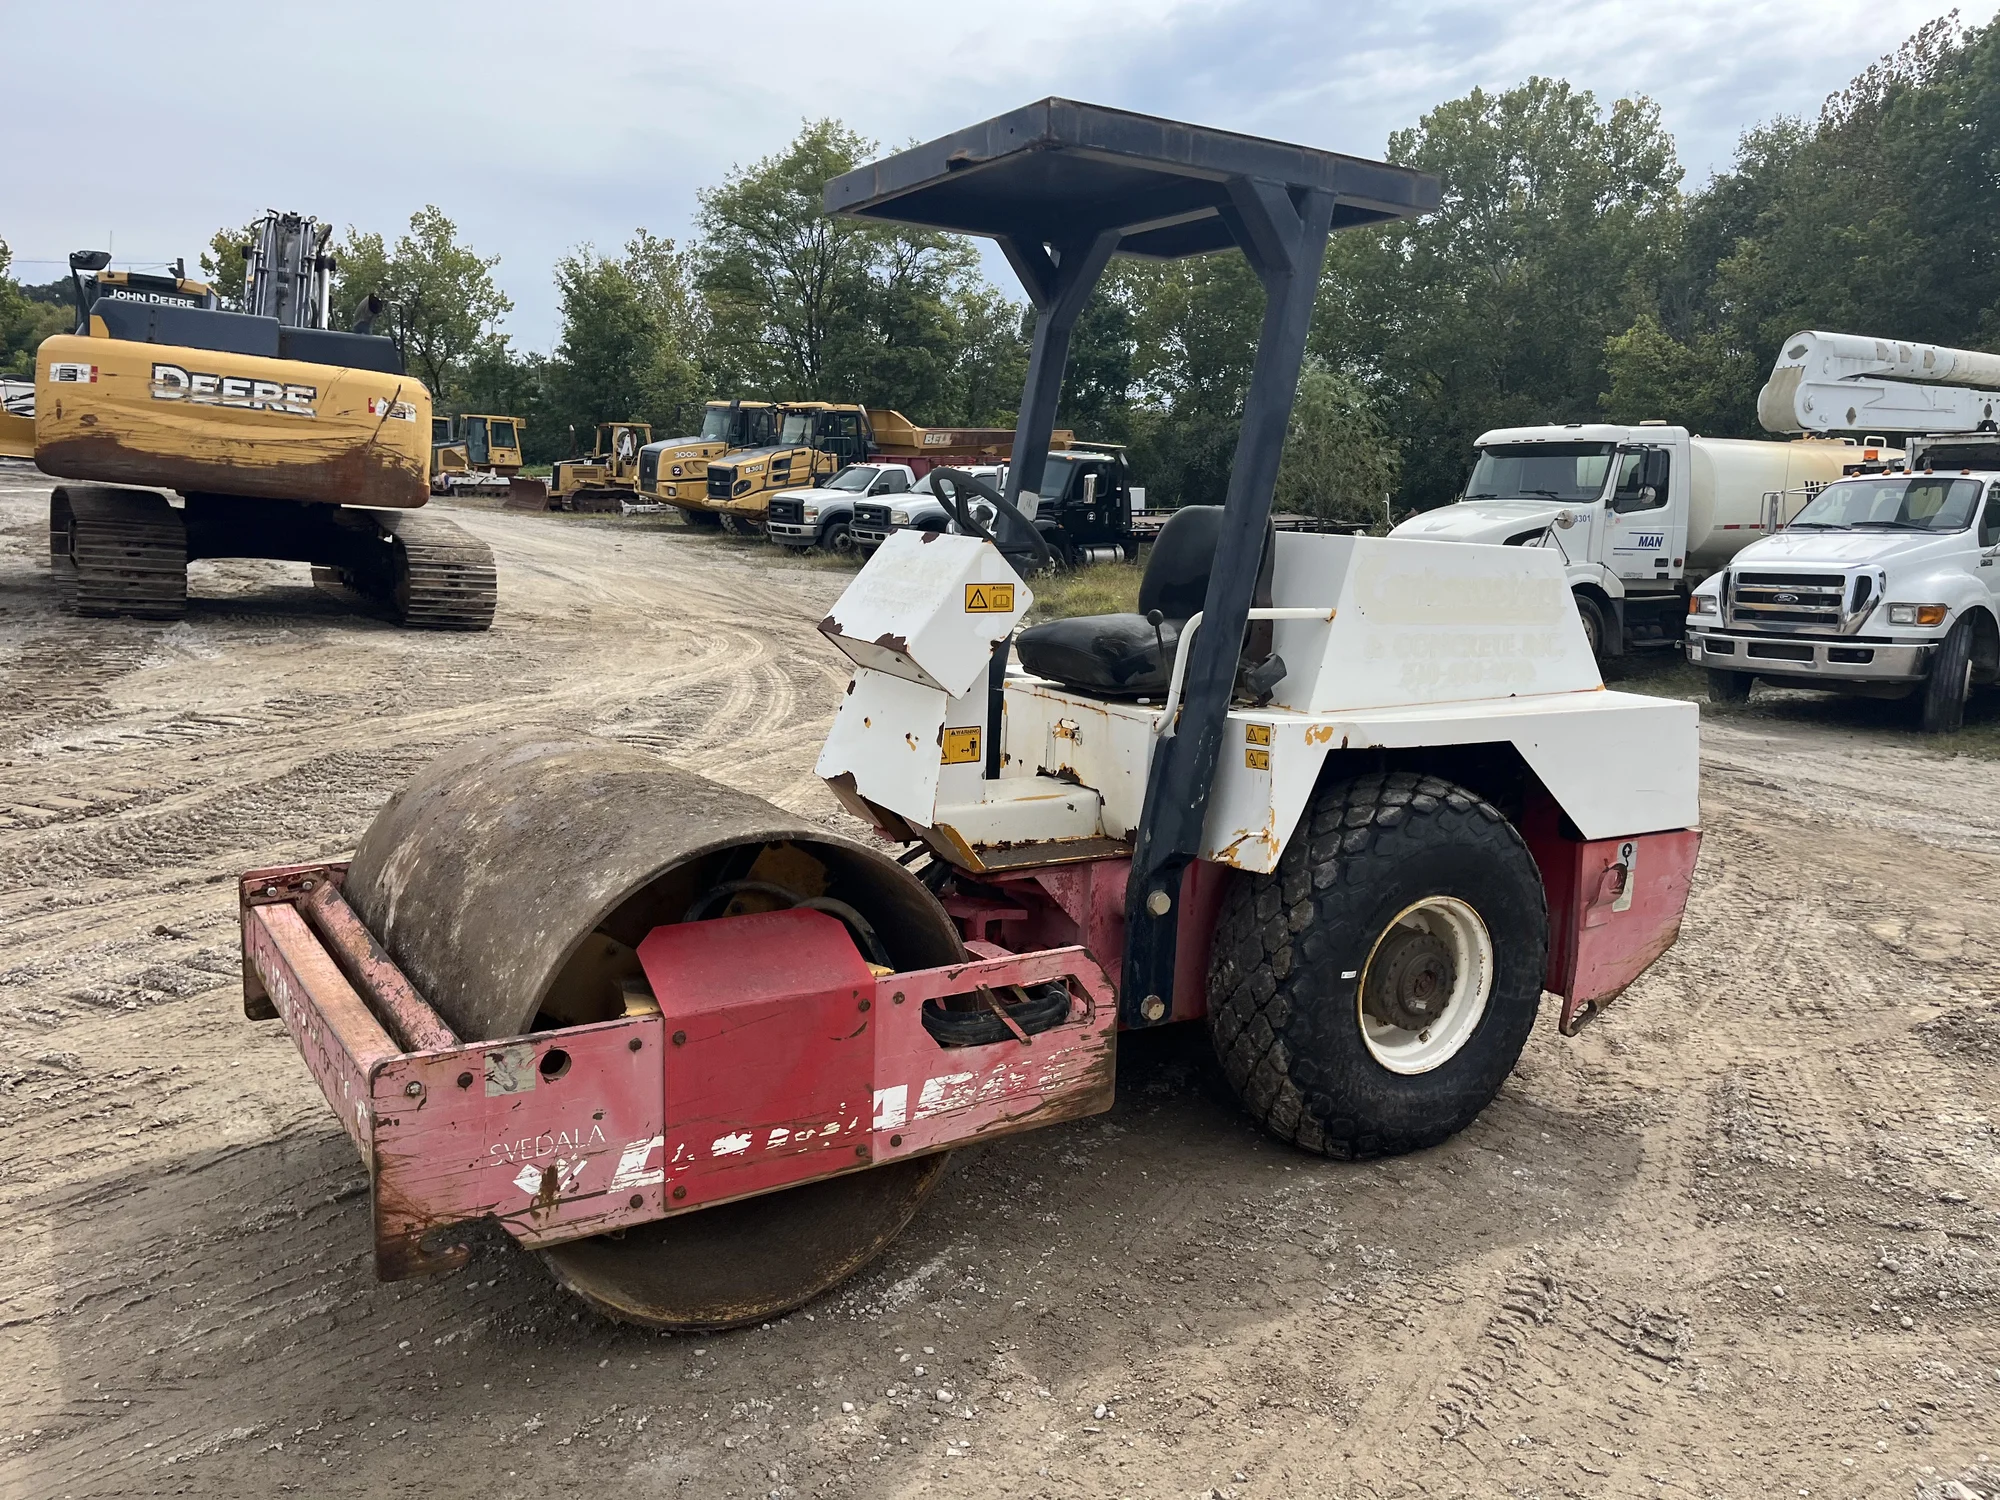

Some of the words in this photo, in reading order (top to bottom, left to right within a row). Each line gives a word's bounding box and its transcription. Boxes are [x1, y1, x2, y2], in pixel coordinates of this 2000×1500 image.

[109, 289, 146, 303] JOHN
[149, 293, 196, 308] DEERE
[152, 364, 317, 418] DEERE
[1638, 535, 1664, 548] MAN
[489, 1124, 607, 1167] SVEDALA
